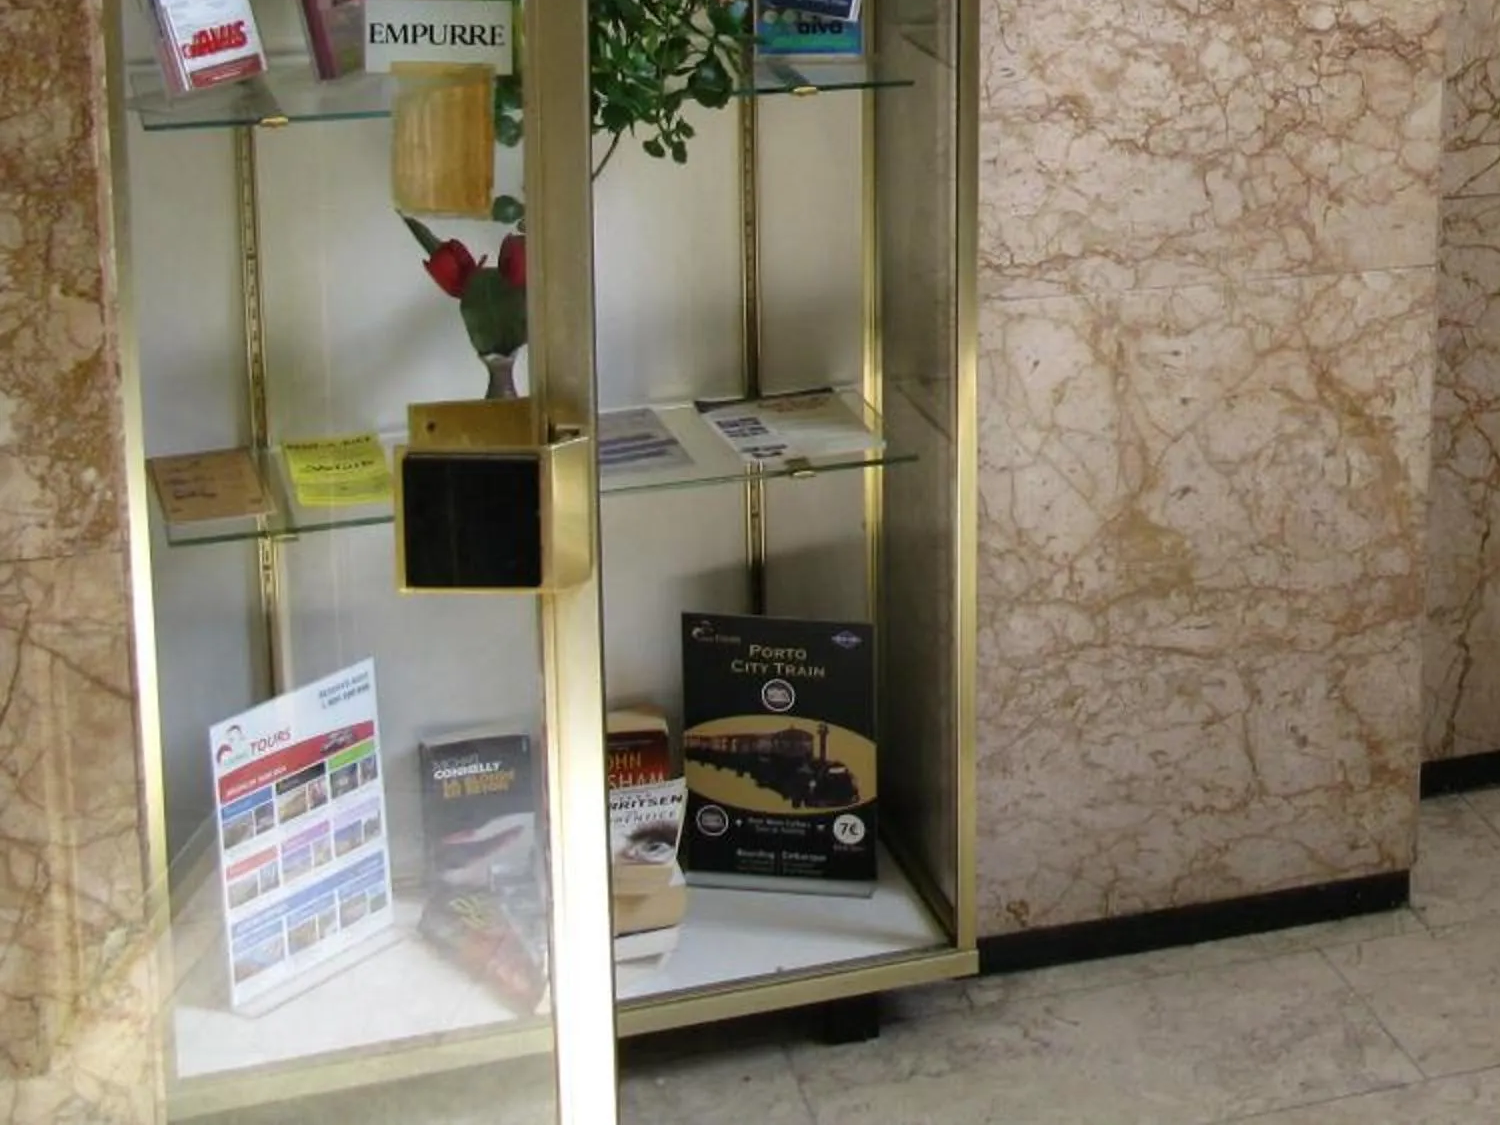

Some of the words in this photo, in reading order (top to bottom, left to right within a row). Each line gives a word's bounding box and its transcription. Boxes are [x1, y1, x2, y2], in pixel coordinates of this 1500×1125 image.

[368, 22, 506, 46] EMPURRE
[750, 643, 807, 661] PORTO
[731, 659, 769, 674] CITY
[774, 662, 826, 678] TRAIN
[250, 729, 292, 756] TOURS
